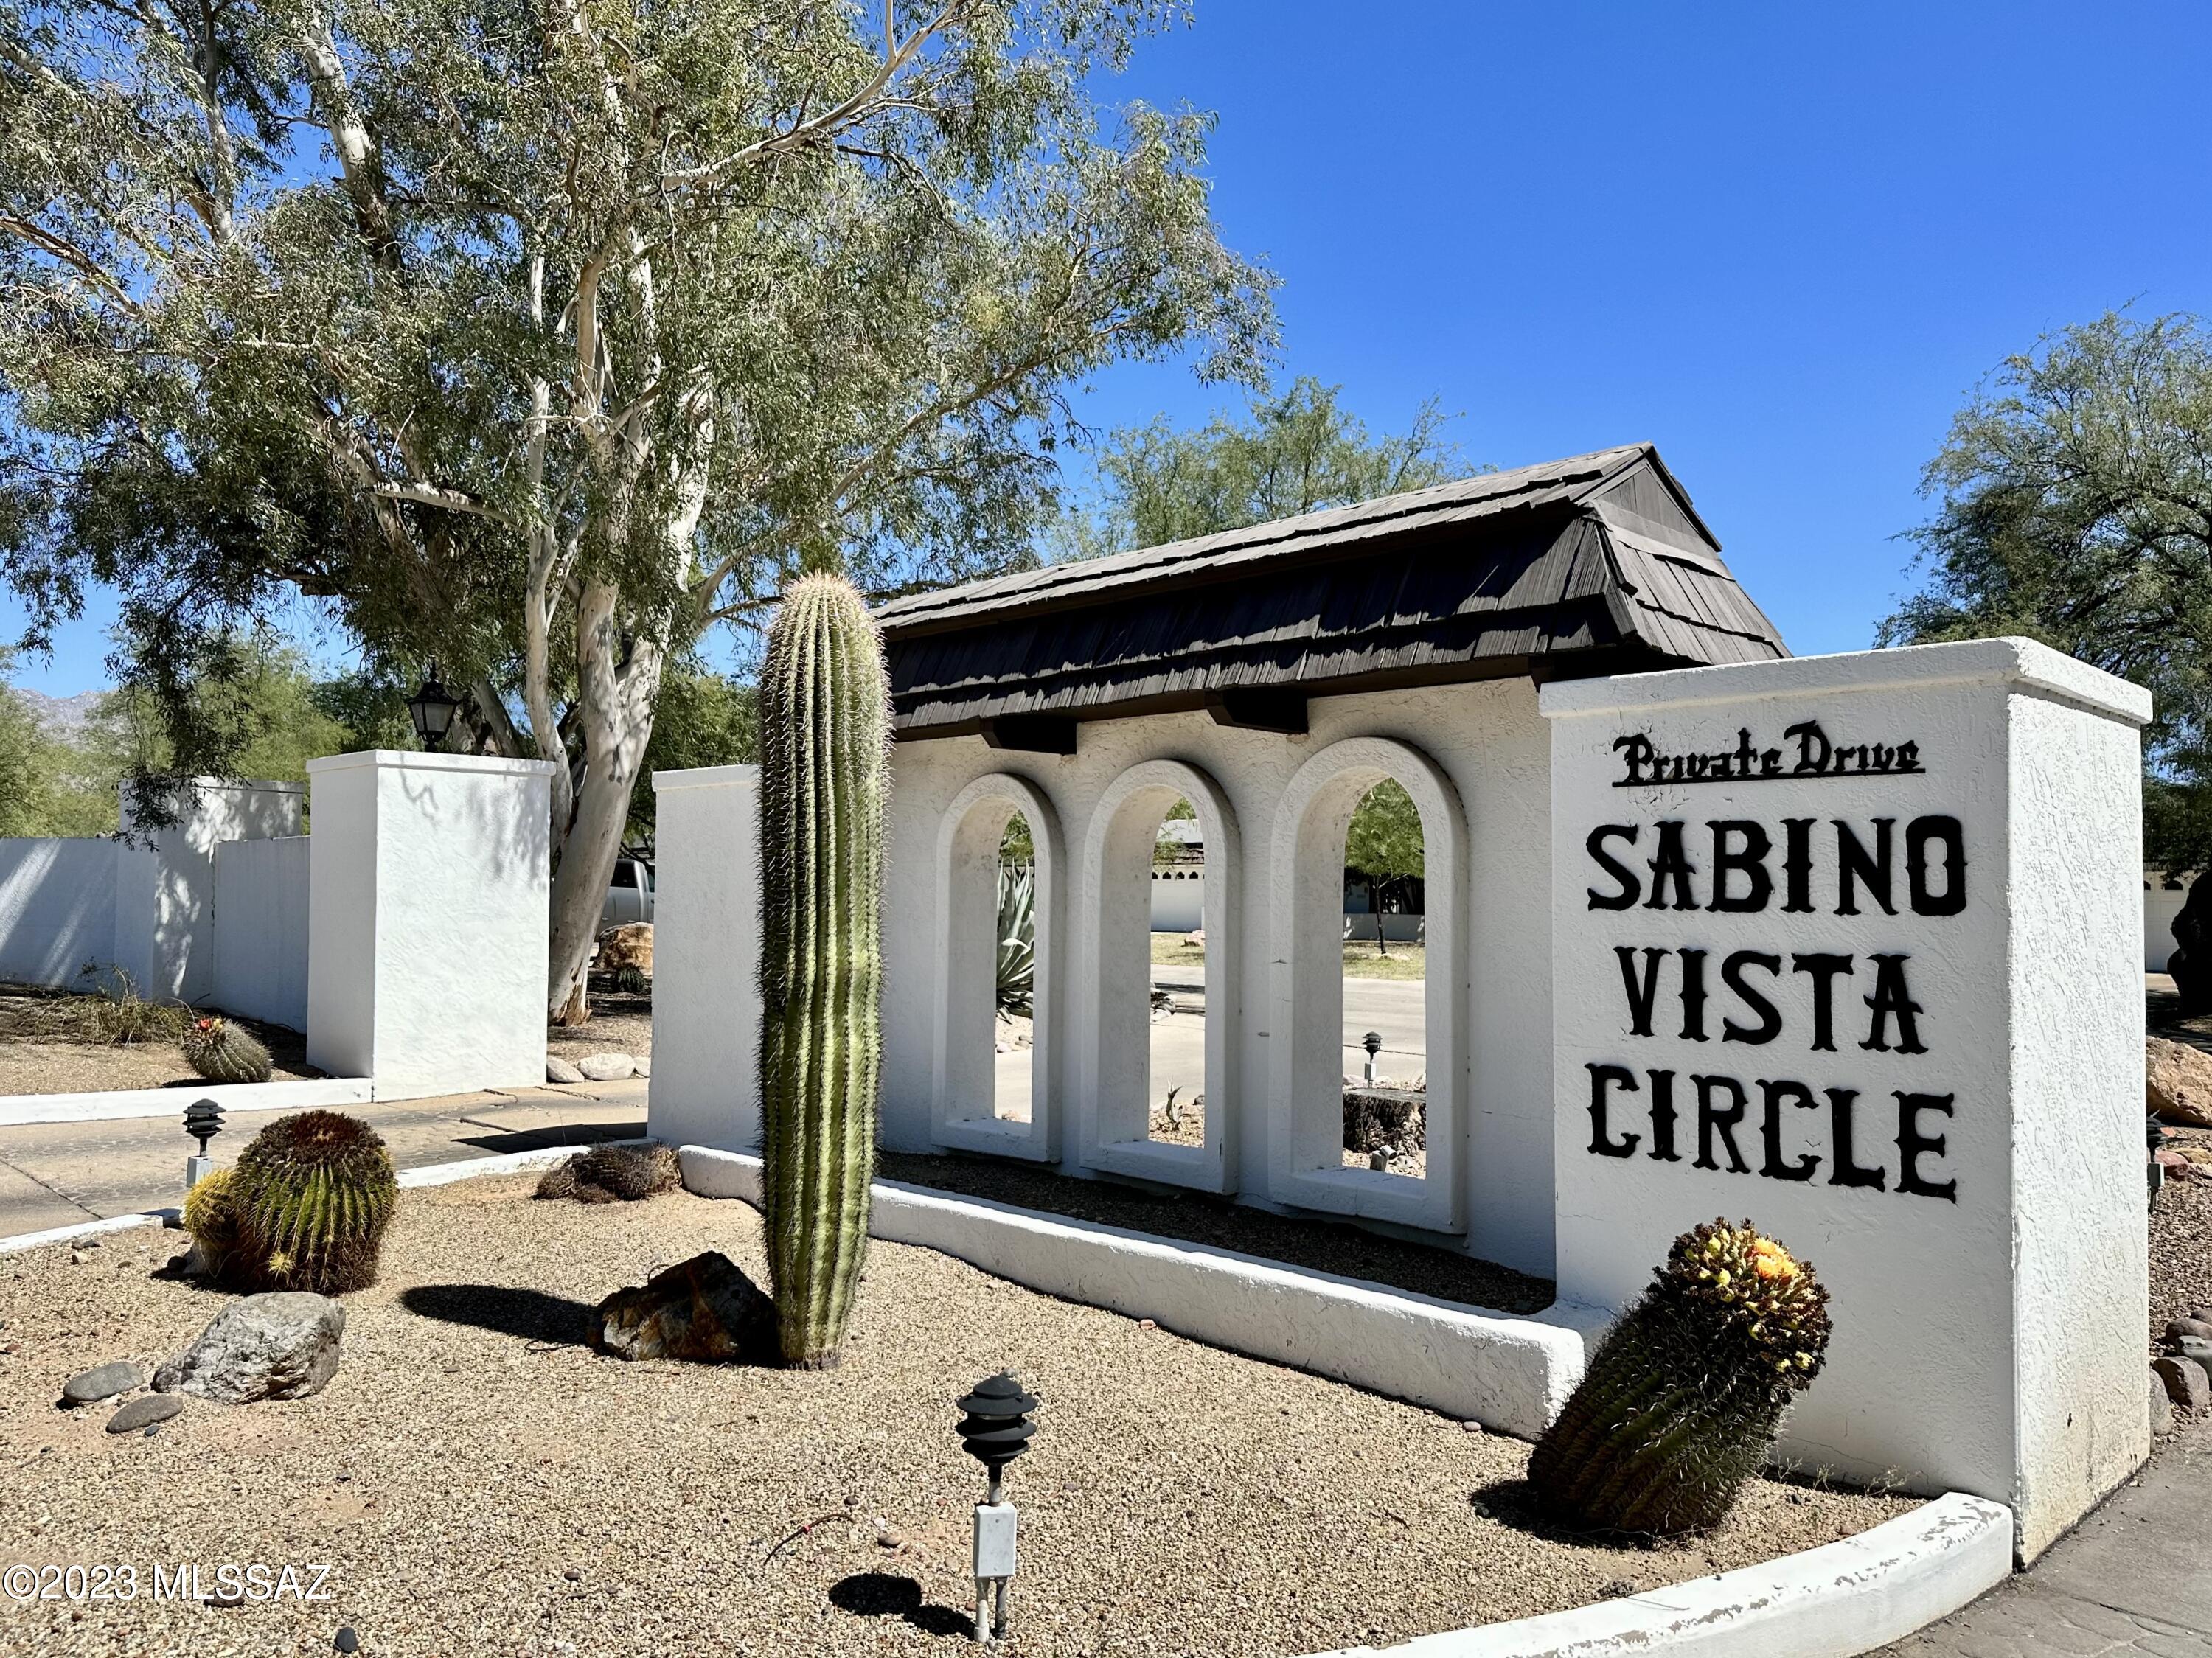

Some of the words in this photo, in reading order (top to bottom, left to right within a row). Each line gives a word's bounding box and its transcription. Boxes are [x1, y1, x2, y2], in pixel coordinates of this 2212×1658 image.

[1612, 727, 1784, 784] Private
[1783, 720, 1921, 775] Drive
[1585, 814, 1969, 916] SABINO
[1613, 946, 1930, 1055] VISTA
[1584, 1062, 1958, 1205] CIRCLE
